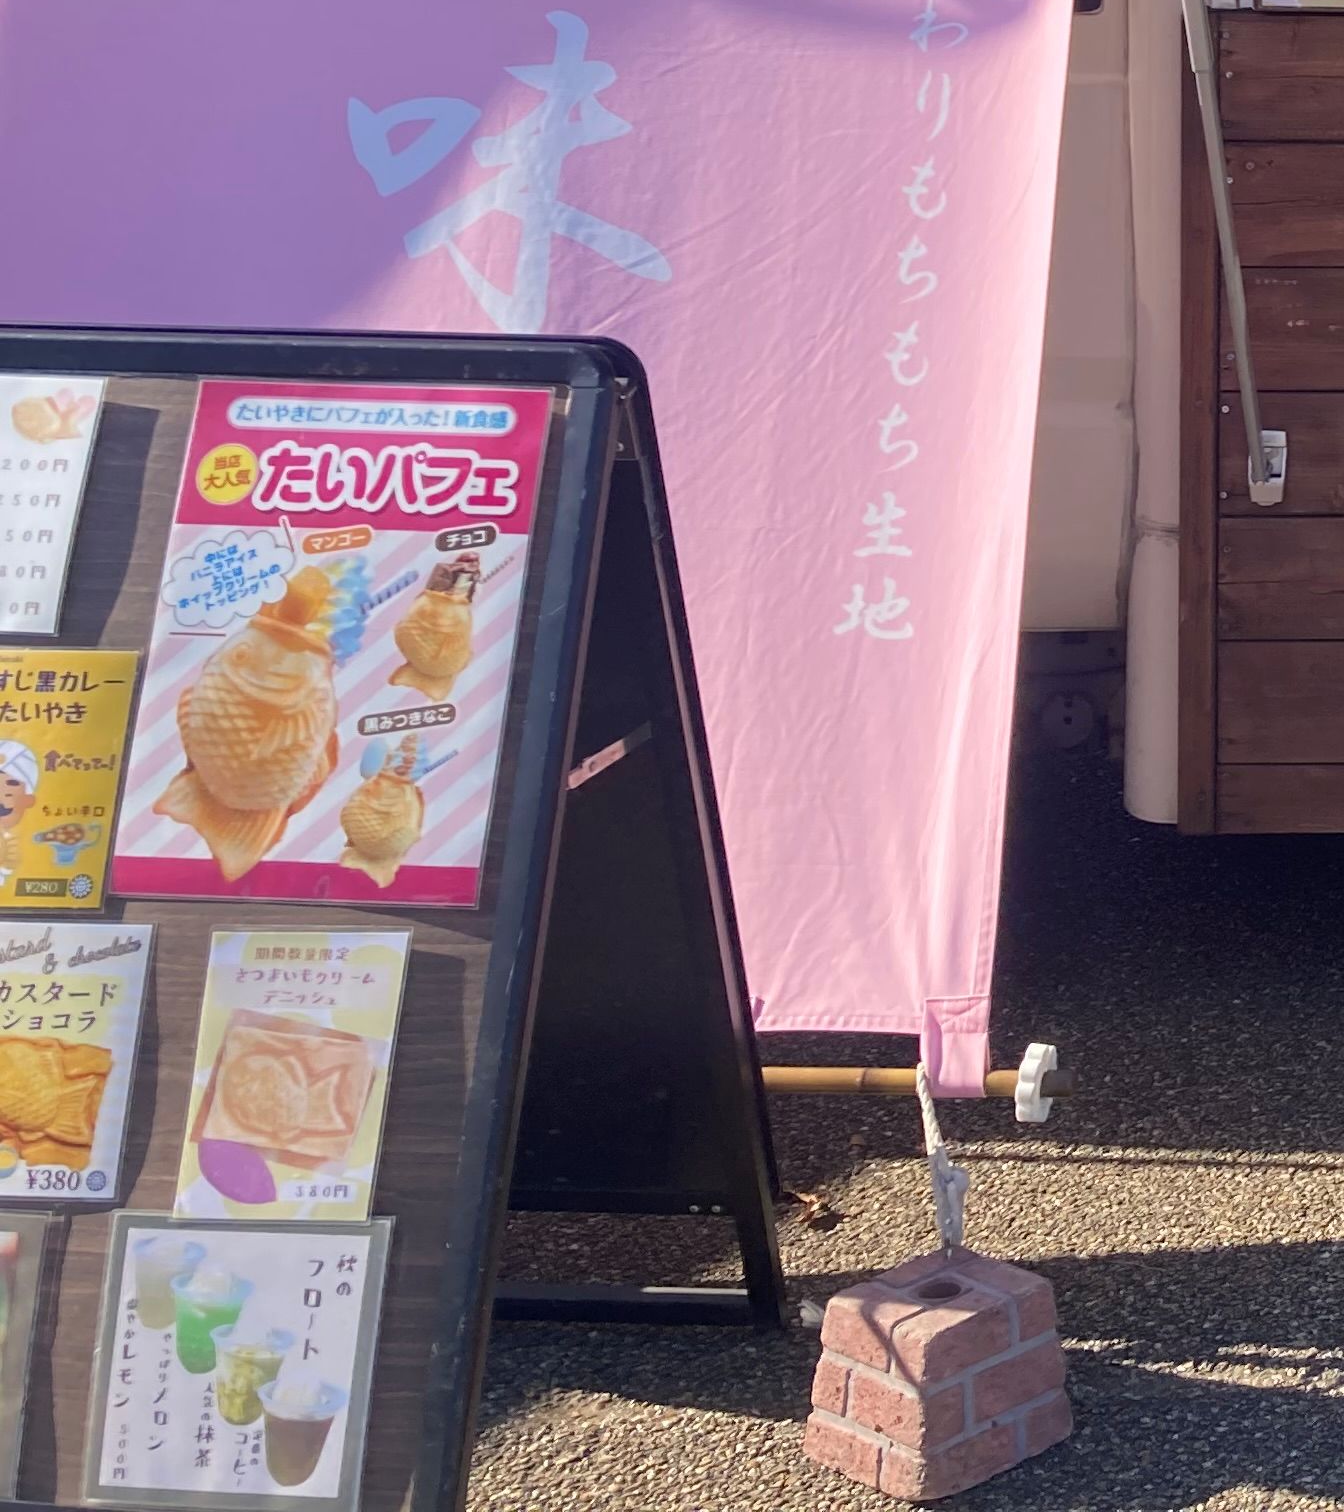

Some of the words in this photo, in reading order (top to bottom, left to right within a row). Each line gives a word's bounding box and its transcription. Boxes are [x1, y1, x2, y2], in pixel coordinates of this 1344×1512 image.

[258, 446, 511, 507] たいパフェ
[310, 532, 366, 549] マンゴー
[445, 530, 488, 548] チョコ
[0, 700, 88, 725] たいやき
[363, 707, 451, 734] 黒みつきなこ
[24, 880, 59, 894] ¥280
[234, 967, 377, 985] さつまいもクリーム
[262, 990, 338, 1006] デニッシュ
[2, 1009, 97, 1034] ショコラ
[26, 1169, 81, 1191] ¥380
[335, 1253, 358, 1297] 秋の
[302, 1259, 325, 1362] フロート
[232, 1431, 249, 1487] コーヒー
